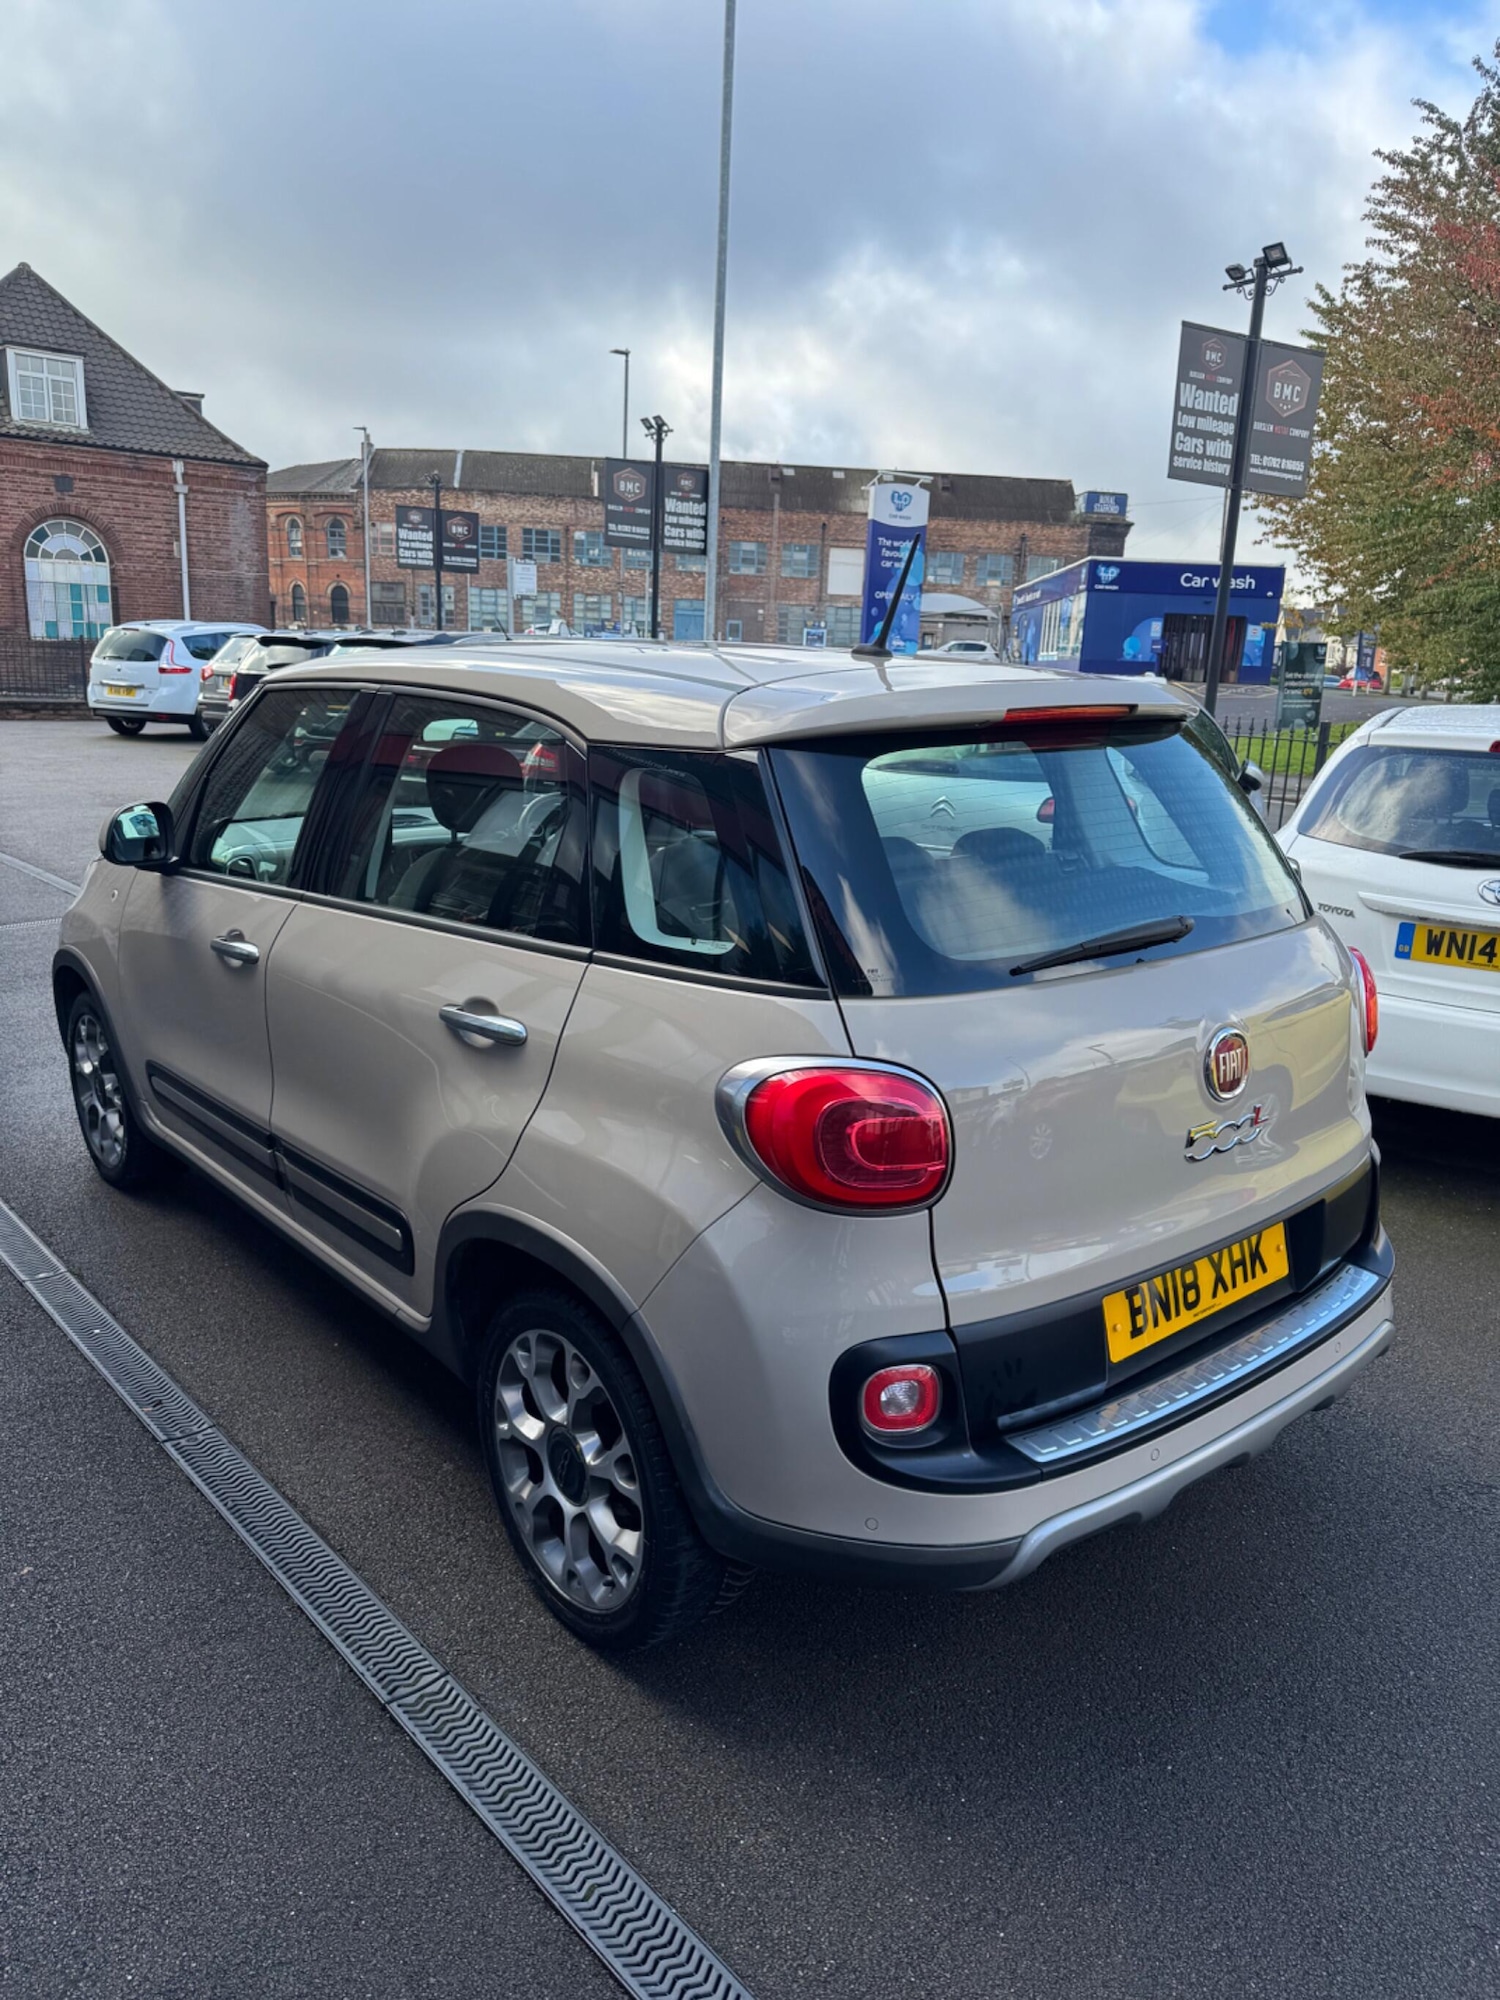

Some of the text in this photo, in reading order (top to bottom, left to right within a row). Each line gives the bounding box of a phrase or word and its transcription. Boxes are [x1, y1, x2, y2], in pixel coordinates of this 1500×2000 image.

[1206, 350, 1222, 362] BMC
[1179, 382, 1240, 417] Wanted
[1273, 381, 1301, 403] BMC
[1177, 411, 1235, 436] Low mileage
[1175, 432, 1233, 459] Cars with
[1173, 455, 1231, 476] service history
[620, 480, 641, 493] BMC
[664, 497, 706, 516] Wanted
[398, 528, 433, 542] Wanted
[452, 526, 469, 535] BMC
[664, 524, 685, 538] Cars
[686, 528, 706, 540] with
[878, 538, 892, 547] The
[1180, 572, 1209, 588] Car
[1317, 902, 1356, 919] TOYOTA
[1426, 928, 1498, 964] WN14
[1219, 1048, 1242, 1084] FIAT
[1123, 1231, 1268, 1340] BN18 XHK
